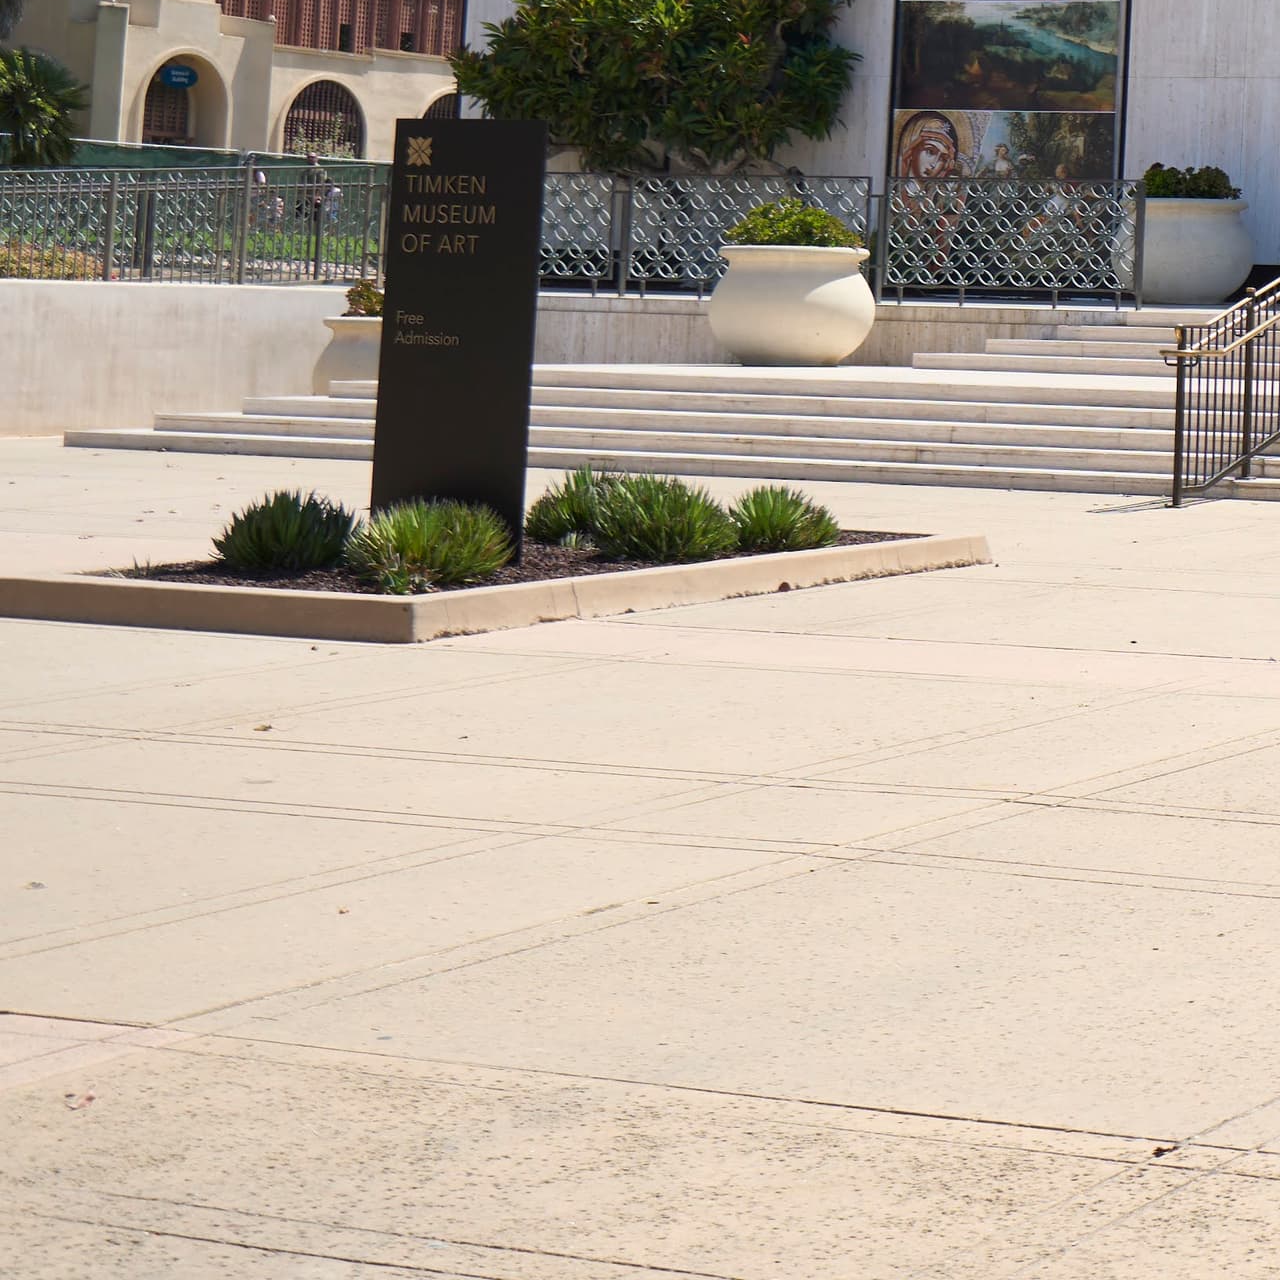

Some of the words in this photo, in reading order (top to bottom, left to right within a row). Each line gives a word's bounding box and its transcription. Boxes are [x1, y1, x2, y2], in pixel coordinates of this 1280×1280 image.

[405, 174, 487, 195] TIMKEN
[402, 204, 497, 225] MUSEUM
[401, 232, 432, 254] OF
[437, 233, 481, 255] ART
[396, 310, 425, 325] Free
[394, 331, 460, 347] Admission
